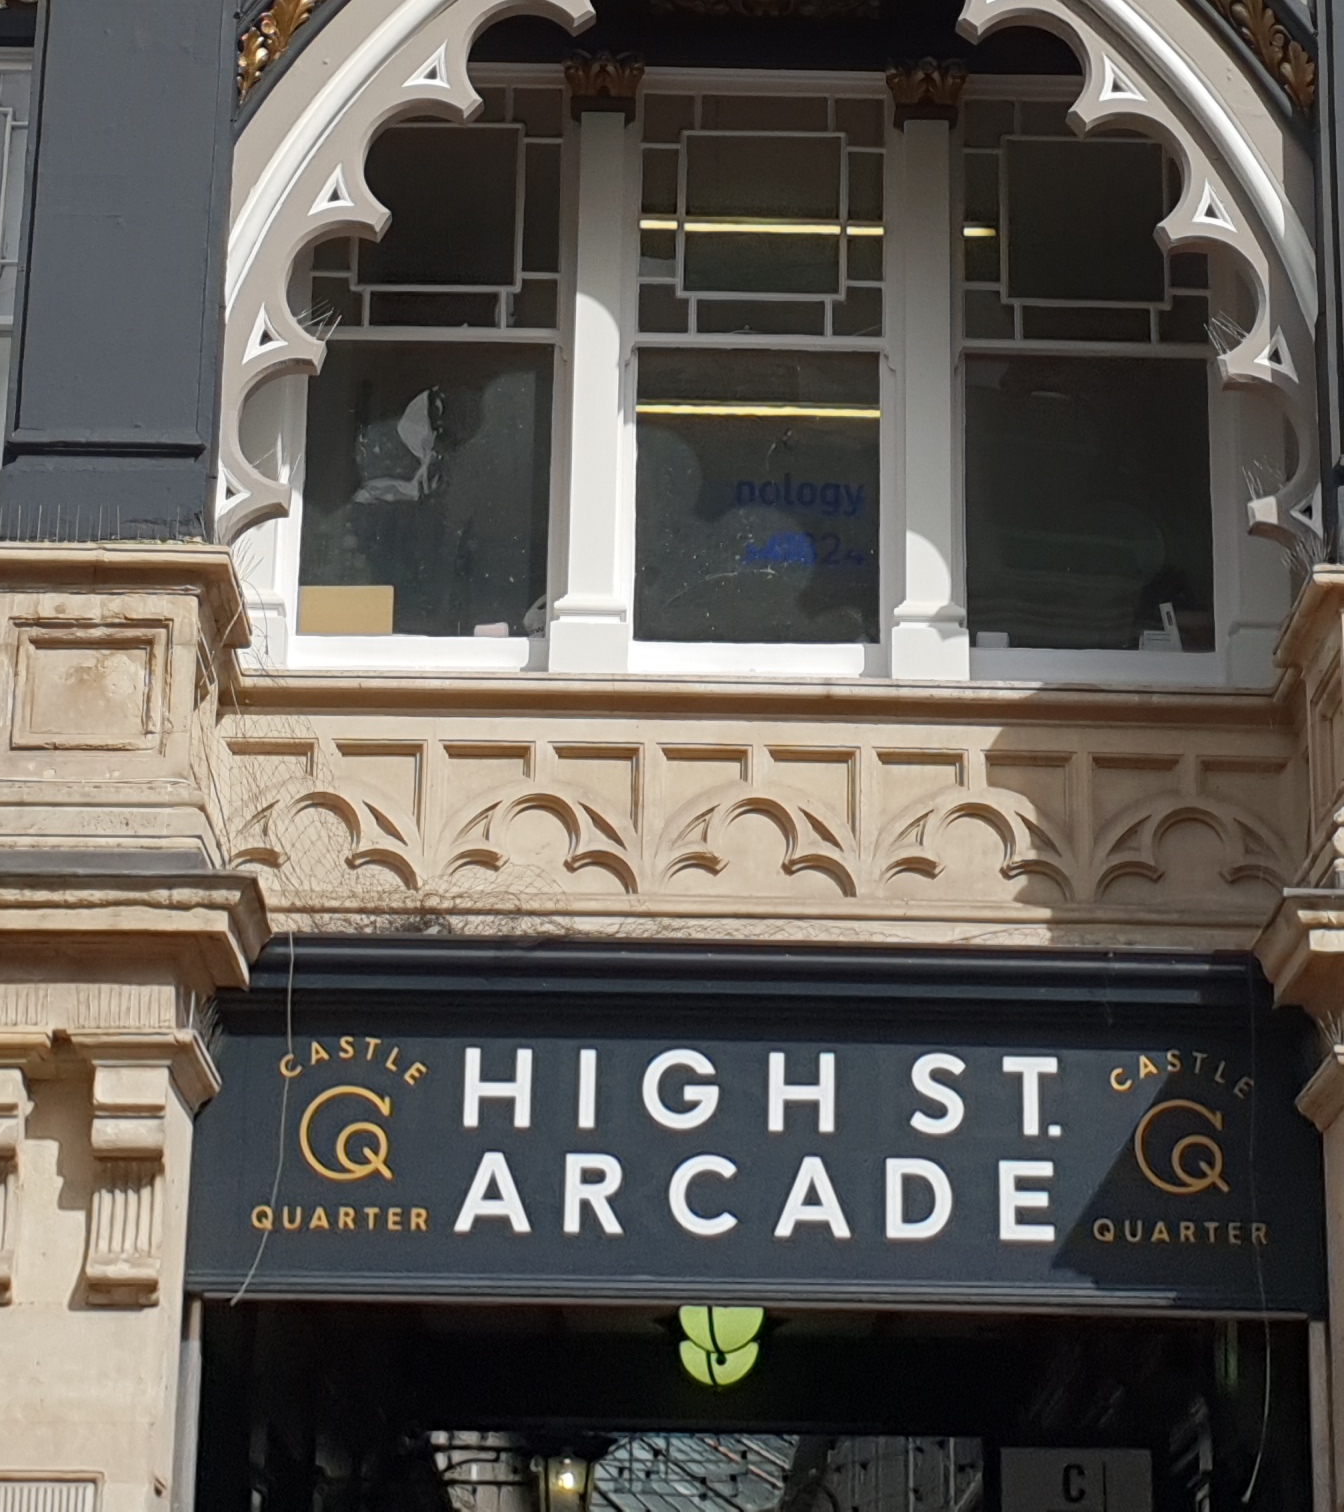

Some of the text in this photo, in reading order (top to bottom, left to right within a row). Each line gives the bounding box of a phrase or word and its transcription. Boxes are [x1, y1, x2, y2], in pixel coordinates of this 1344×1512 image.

[280, 1036, 427, 1086] CASTLE
[1110, 1049, 1254, 1099] CASTLE
[462, 1047, 1062, 1137] HIGH ST.
[251, 1205, 427, 1231] QUARTER
[453, 1151, 1056, 1242] ARCADE
[1093, 1217, 1267, 1245] QUARTER
